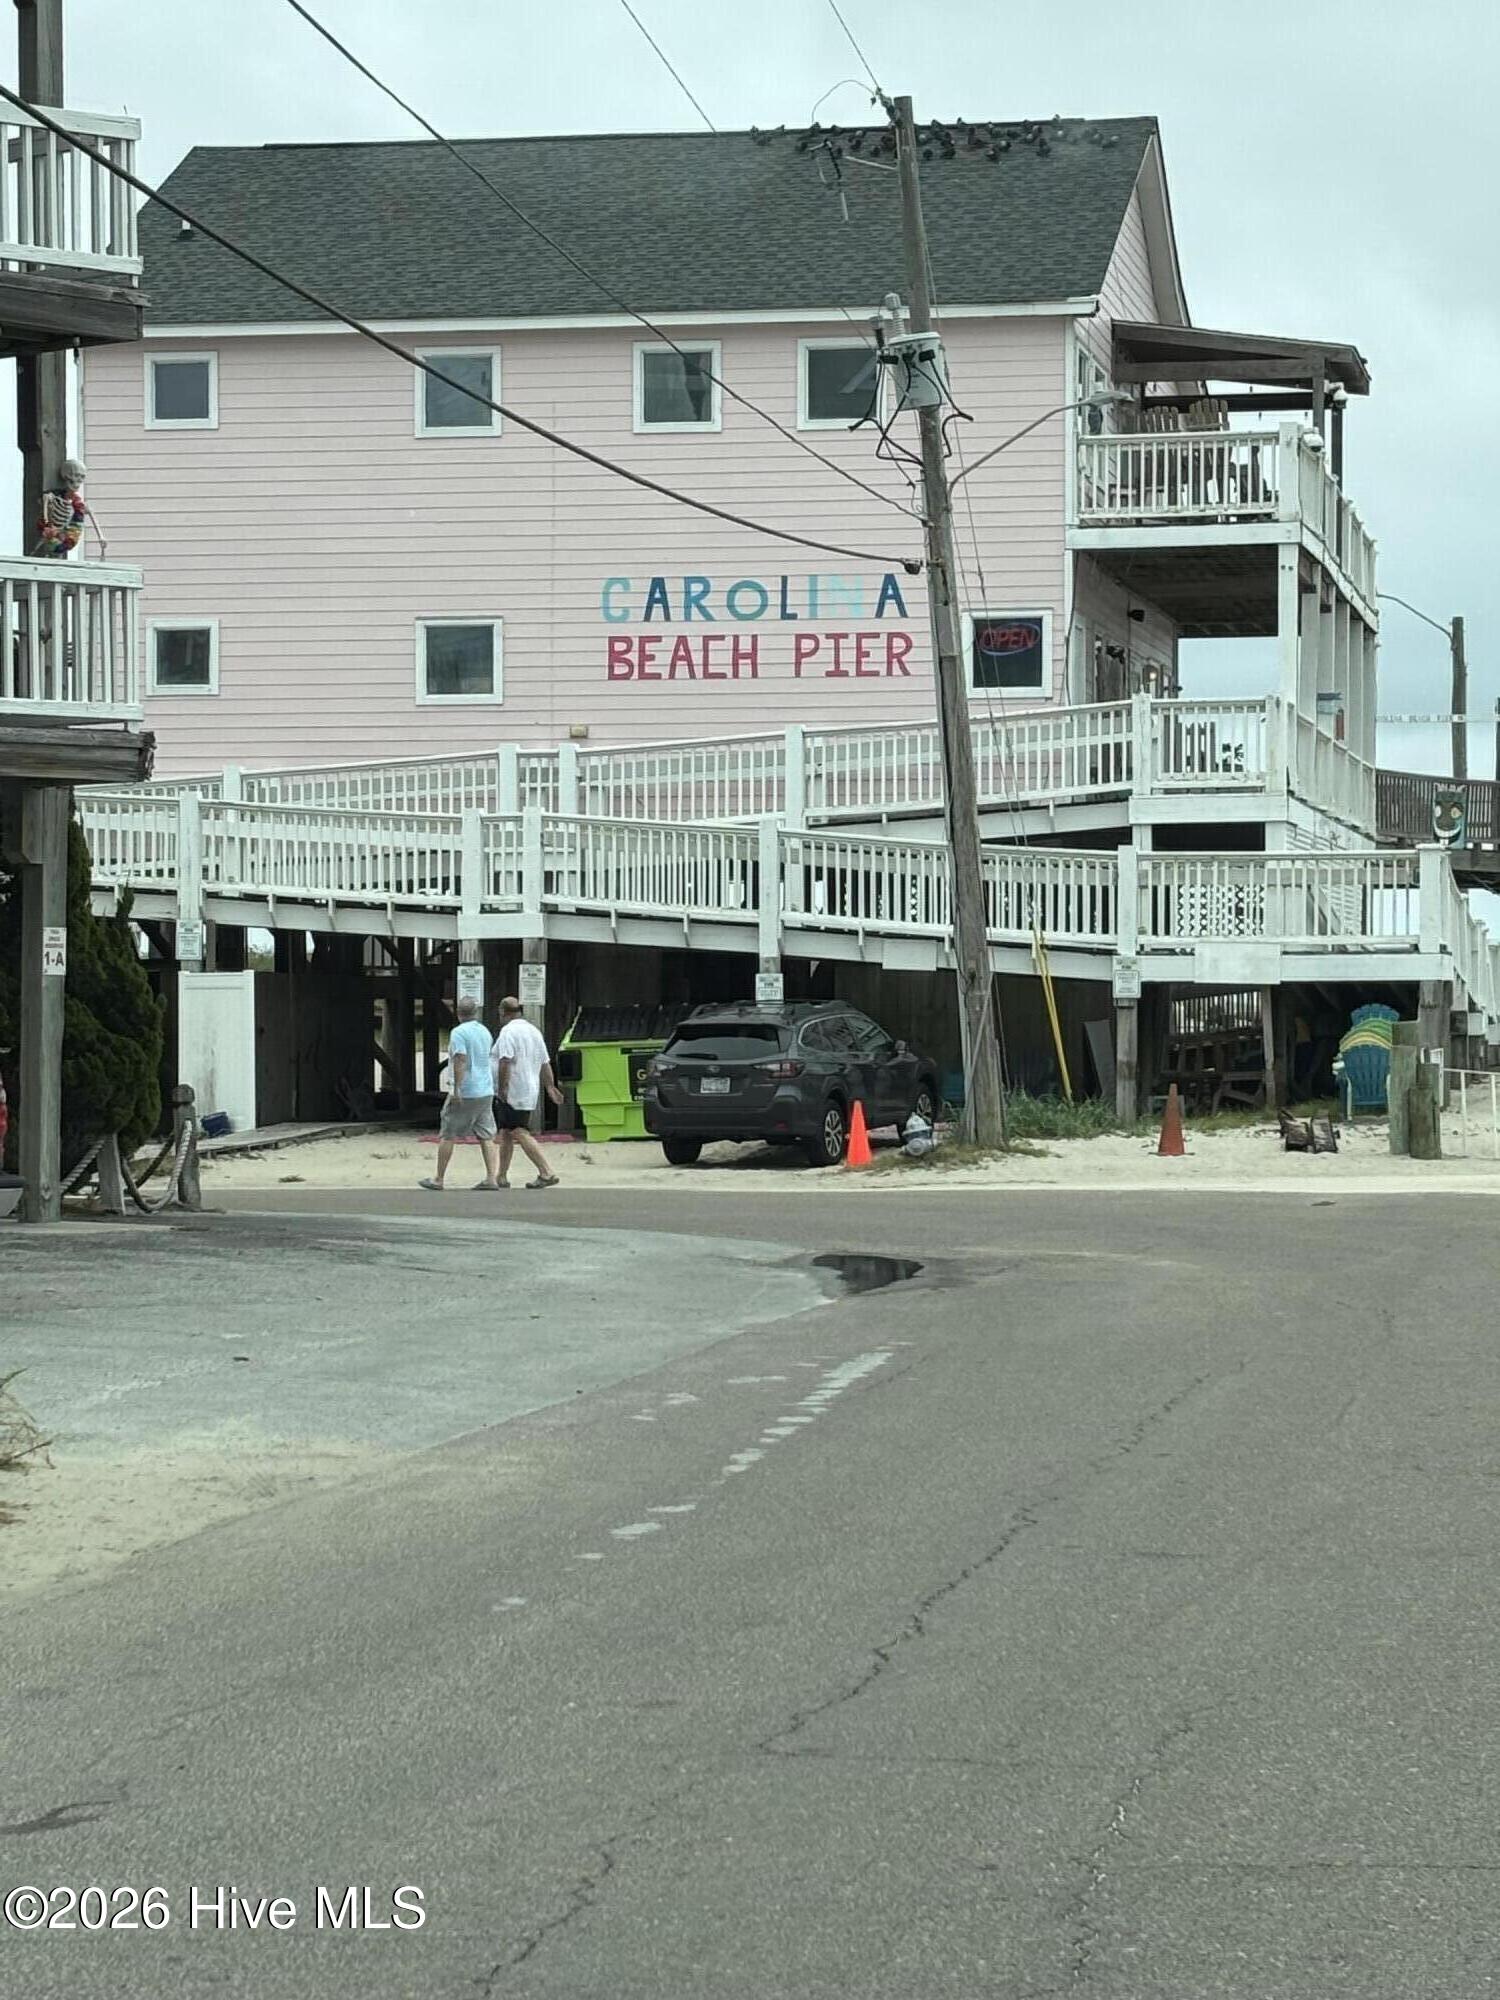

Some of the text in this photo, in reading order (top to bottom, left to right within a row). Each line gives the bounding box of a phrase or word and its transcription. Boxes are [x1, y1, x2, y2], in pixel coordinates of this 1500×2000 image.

[602, 573, 909, 623] CAROLINA
[607, 631, 913, 681] BEACH PIER
[981, 627, 1036, 651] OPEN
